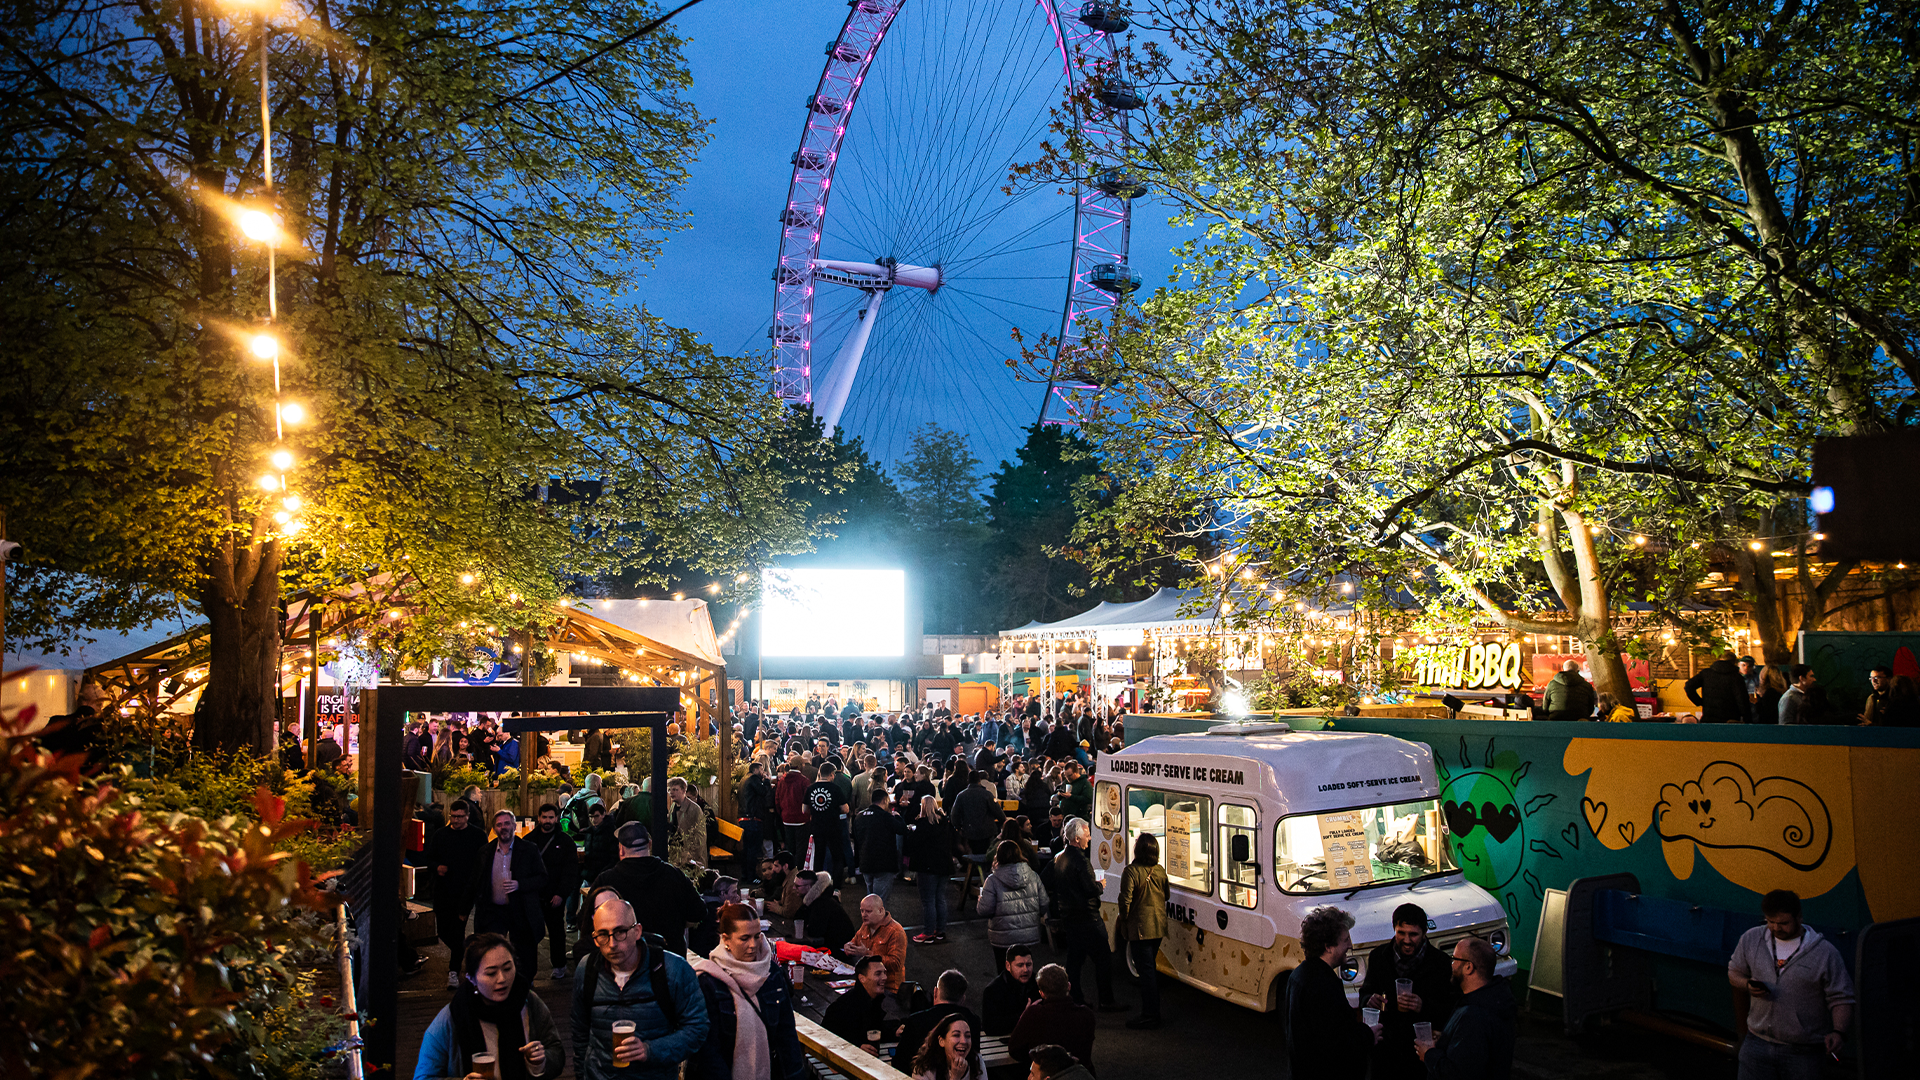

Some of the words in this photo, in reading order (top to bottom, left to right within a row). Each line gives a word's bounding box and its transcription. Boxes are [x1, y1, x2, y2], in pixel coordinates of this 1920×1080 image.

[1467, 642, 1522, 690] BBQ
[317, 694, 360, 705] IRGIIA
[320, 704, 330, 714] IS
[1111, 760, 1139, 774] LOADED
[1141, 762, 1190, 780] SOFT-SERVE
[1193, 766, 1208, 781] ICE
[1209, 768, 1244, 786] CREAM
[1318, 783, 1345, 792] LOADED
[1347, 779, 1387, 789] SOFT-SERVE
[1400, 775, 1421, 784] CREAM
[1325, 815, 1353, 823] CRUMBLE
[1166, 901, 1196, 926] MBLE
